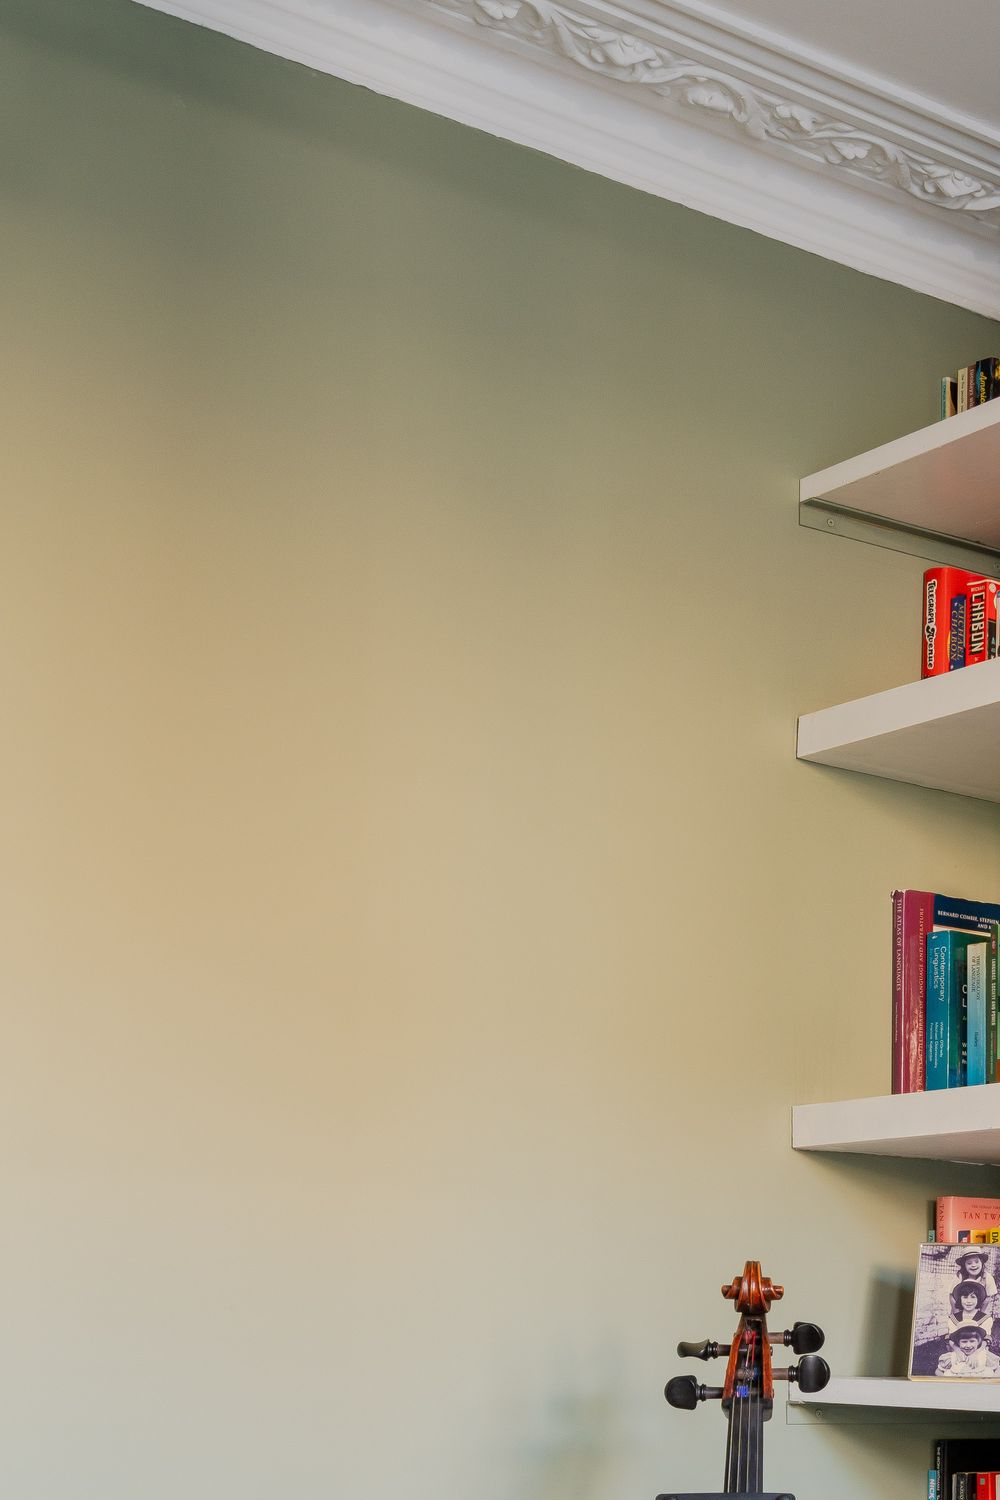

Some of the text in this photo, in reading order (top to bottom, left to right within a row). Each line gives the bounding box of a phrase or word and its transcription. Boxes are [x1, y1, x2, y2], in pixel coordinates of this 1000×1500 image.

[926, 581, 936, 669] TELEGRAPH Avenue
[951, 610, 959, 660] CHABON
[971, 592, 986, 654] CHABON
[937, 910, 959, 918] BERNARD
[939, 946, 947, 1002] Contemporary
